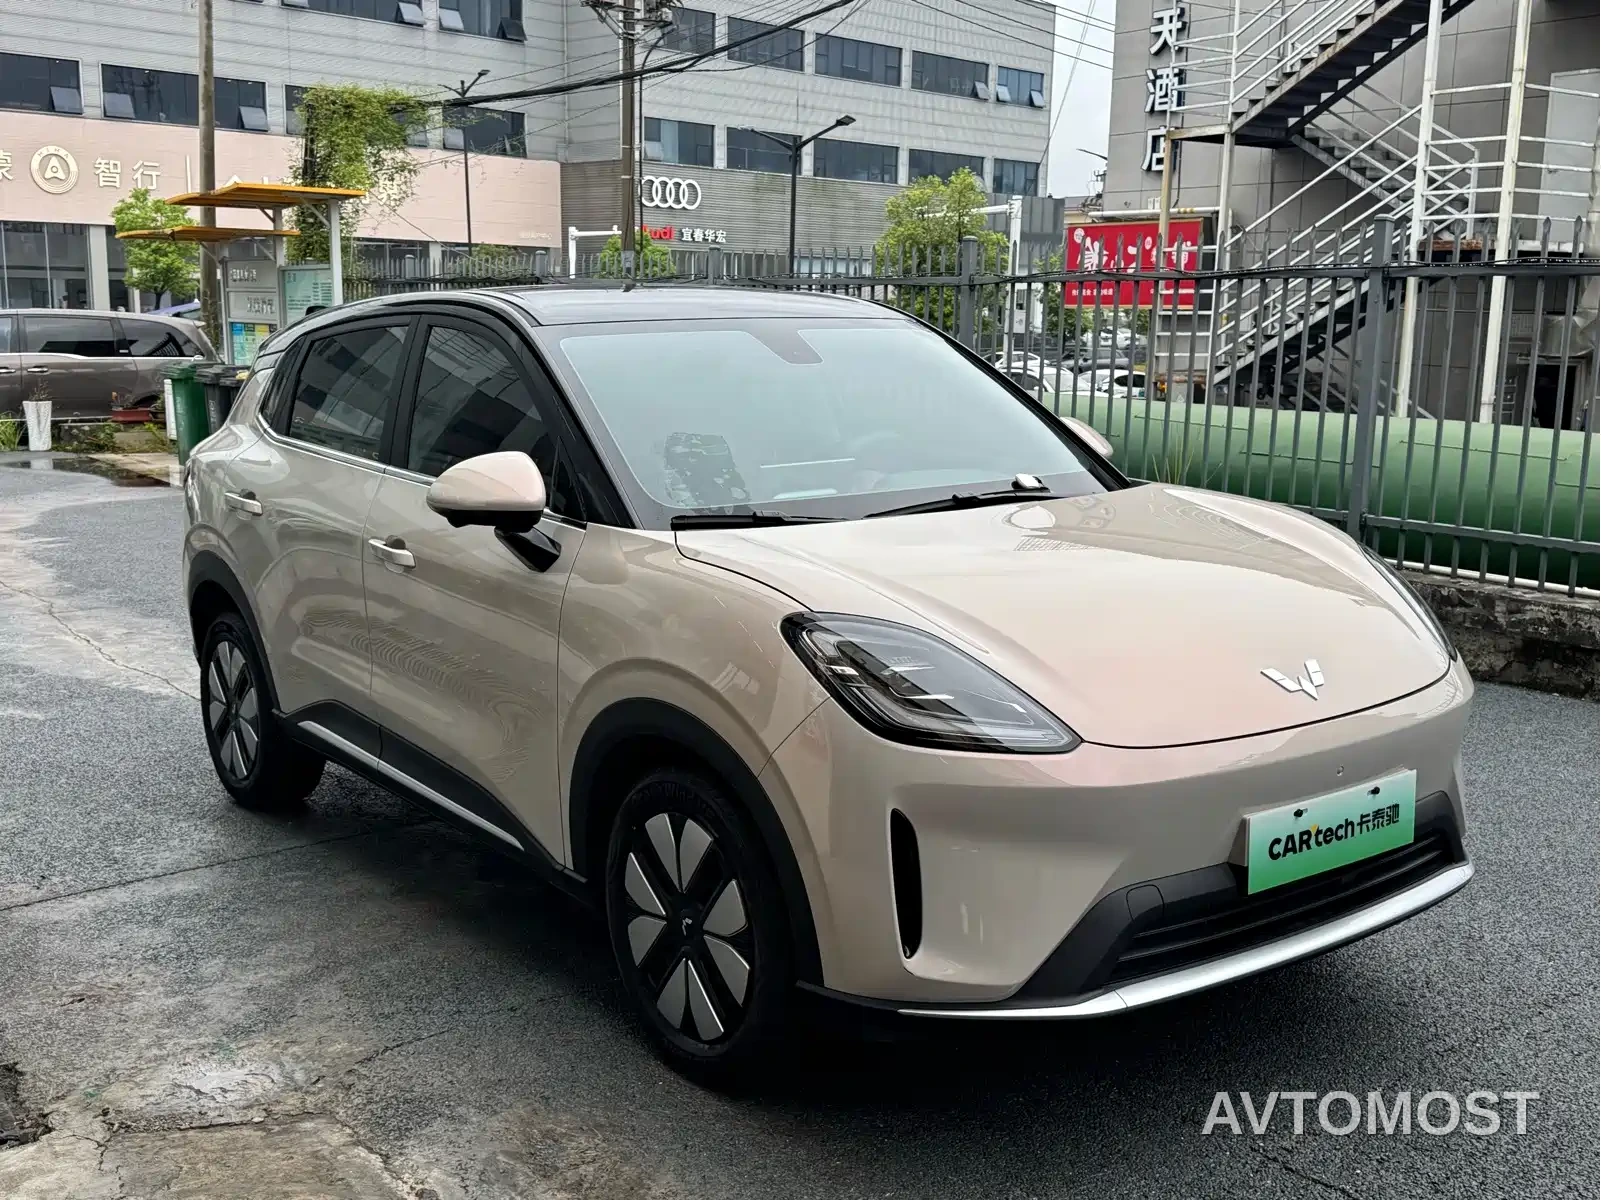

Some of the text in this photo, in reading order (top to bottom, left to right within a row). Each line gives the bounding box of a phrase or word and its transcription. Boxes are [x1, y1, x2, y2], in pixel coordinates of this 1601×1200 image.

[94, 156, 161, 190] 智行
[681, 227, 727, 243] 宜春华宏
[1268, 803, 1400, 861] CARtech 卡泰驰
